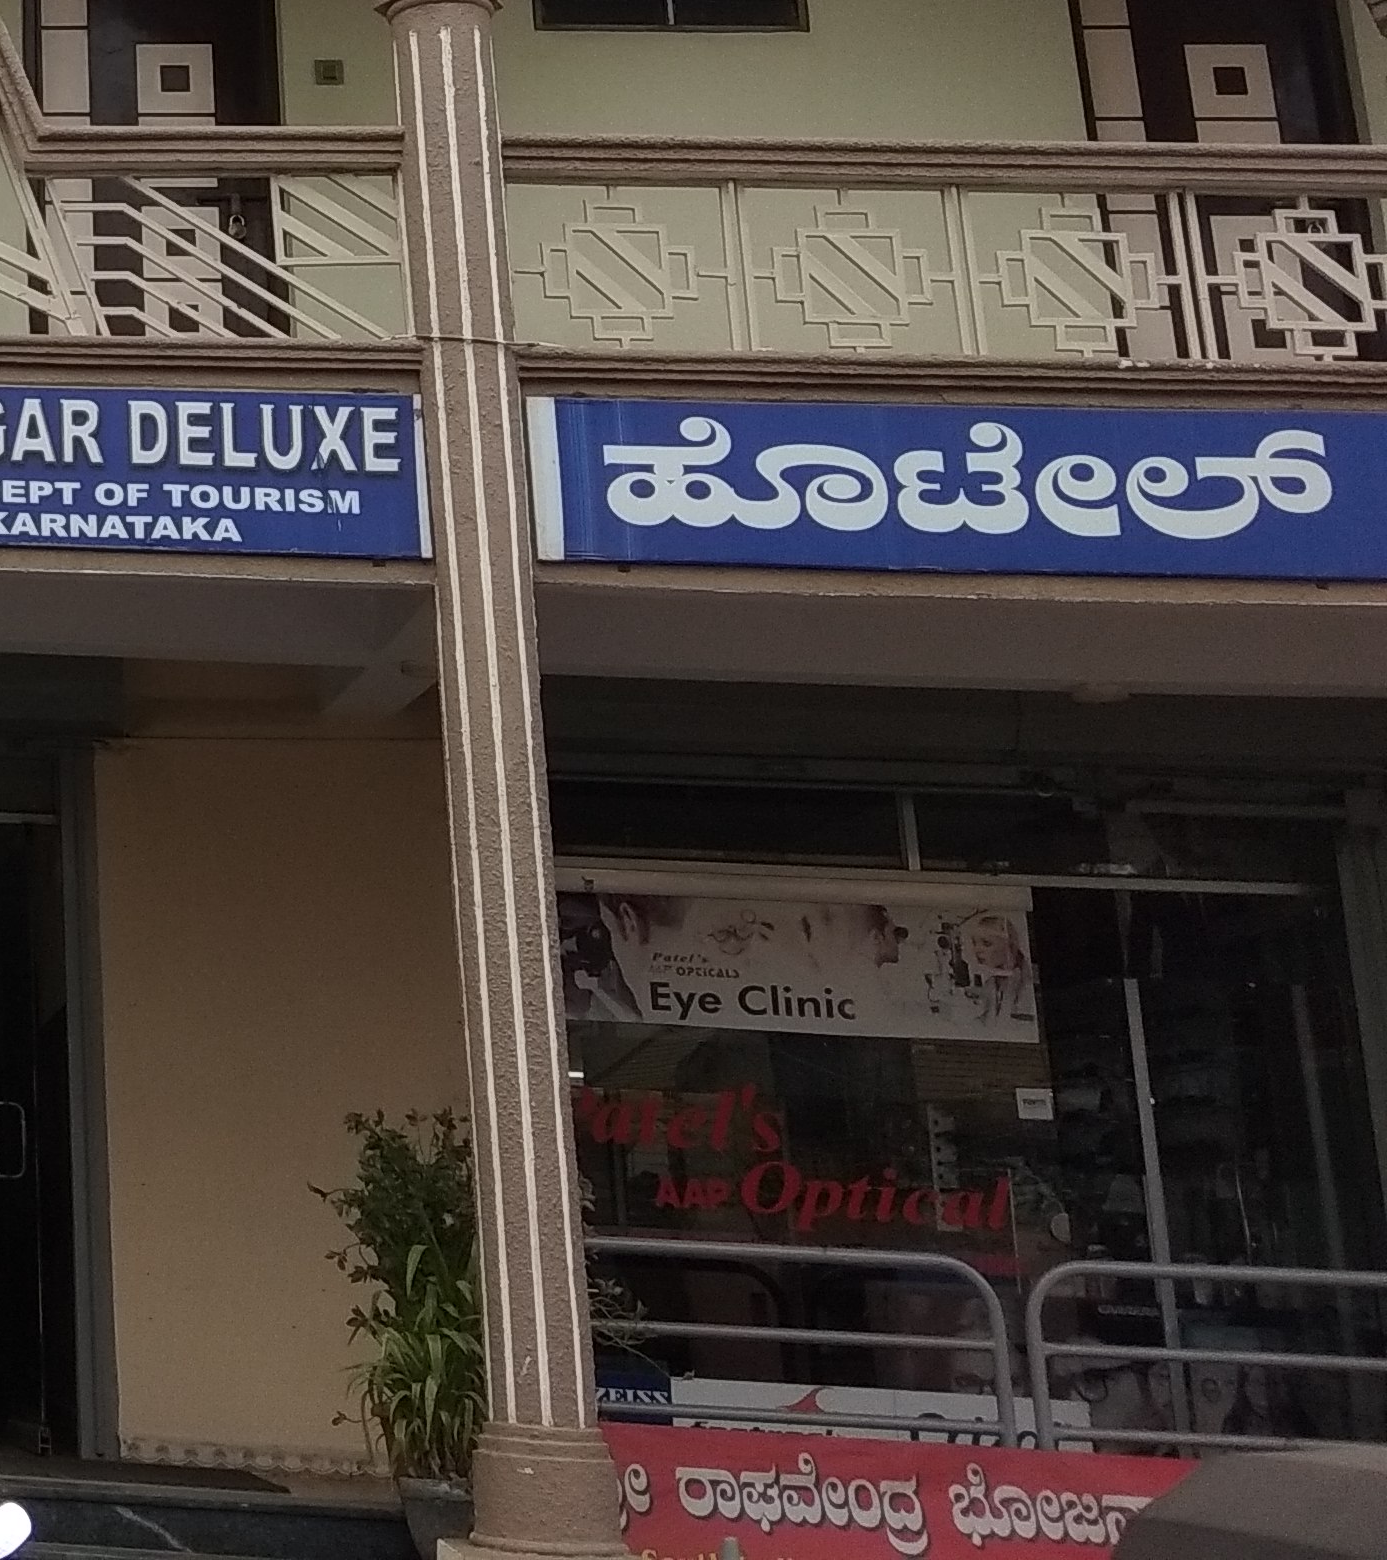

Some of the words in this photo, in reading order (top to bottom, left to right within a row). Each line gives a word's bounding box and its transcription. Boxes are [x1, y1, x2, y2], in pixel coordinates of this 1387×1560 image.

[127, 399, 403, 473] DELUXE
[94, 483, 149, 507] OF
[162, 483, 361, 515] TOURISM
[652, 952, 709, 964] Patel's
[676, 966, 740, 979] OPTICALS
[649, 981, 723, 1020] Eye
[737, 984, 857, 1020] Clinic
[655, 1175, 730, 1210] AAP
[740, 1160, 1012, 1232] Optical
